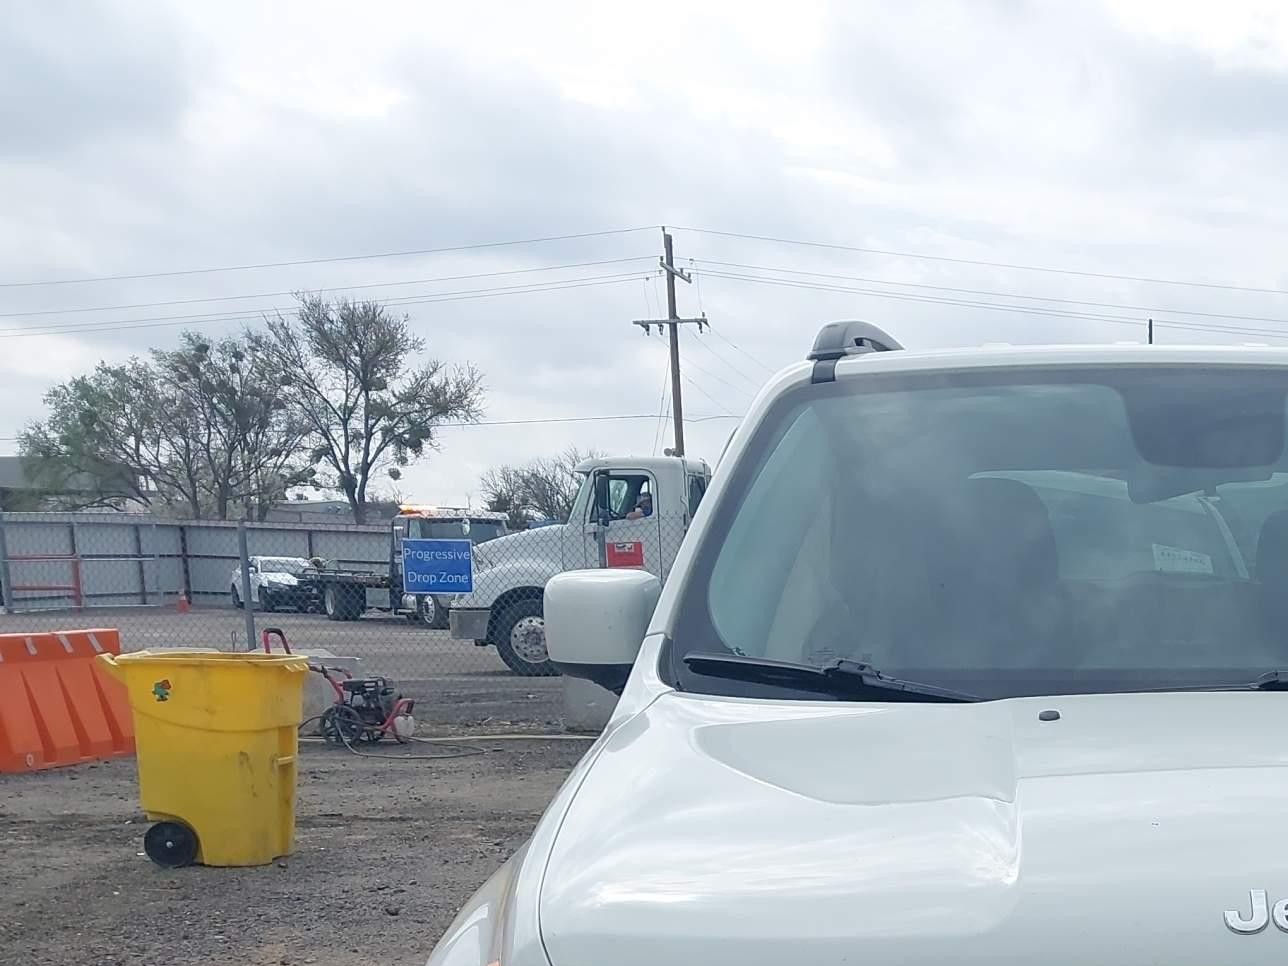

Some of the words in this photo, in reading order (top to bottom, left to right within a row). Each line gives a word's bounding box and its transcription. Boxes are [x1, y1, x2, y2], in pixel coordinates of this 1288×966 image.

[403, 547, 471, 562] Progressive
[407, 571, 437, 585] Drop
[439, 571, 469, 583] Zone
